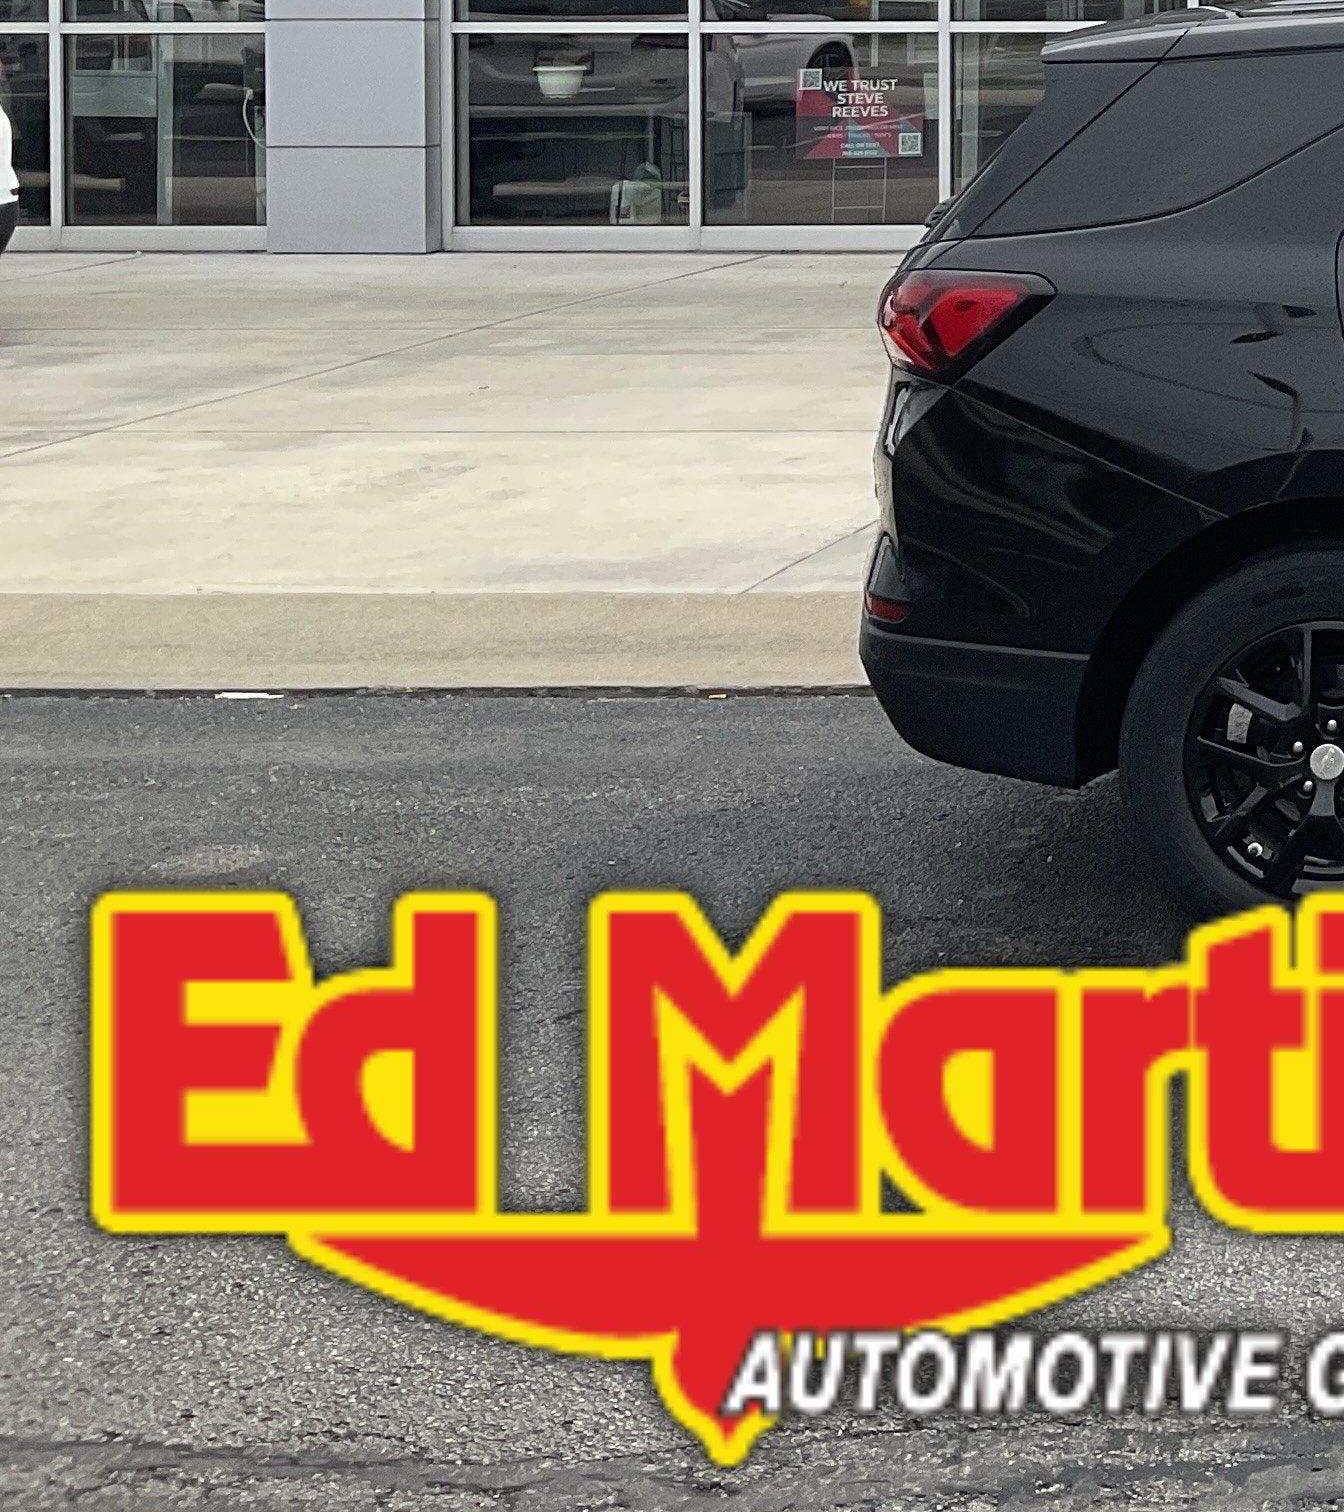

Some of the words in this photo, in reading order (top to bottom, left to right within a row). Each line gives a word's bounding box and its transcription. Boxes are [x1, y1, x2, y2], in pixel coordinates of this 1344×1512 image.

[823, 80, 848, 92] WE
[851, 79, 899, 91] TRUST
[837, 92, 884, 105] STEVE
[832, 105, 889, 118] REEVES
